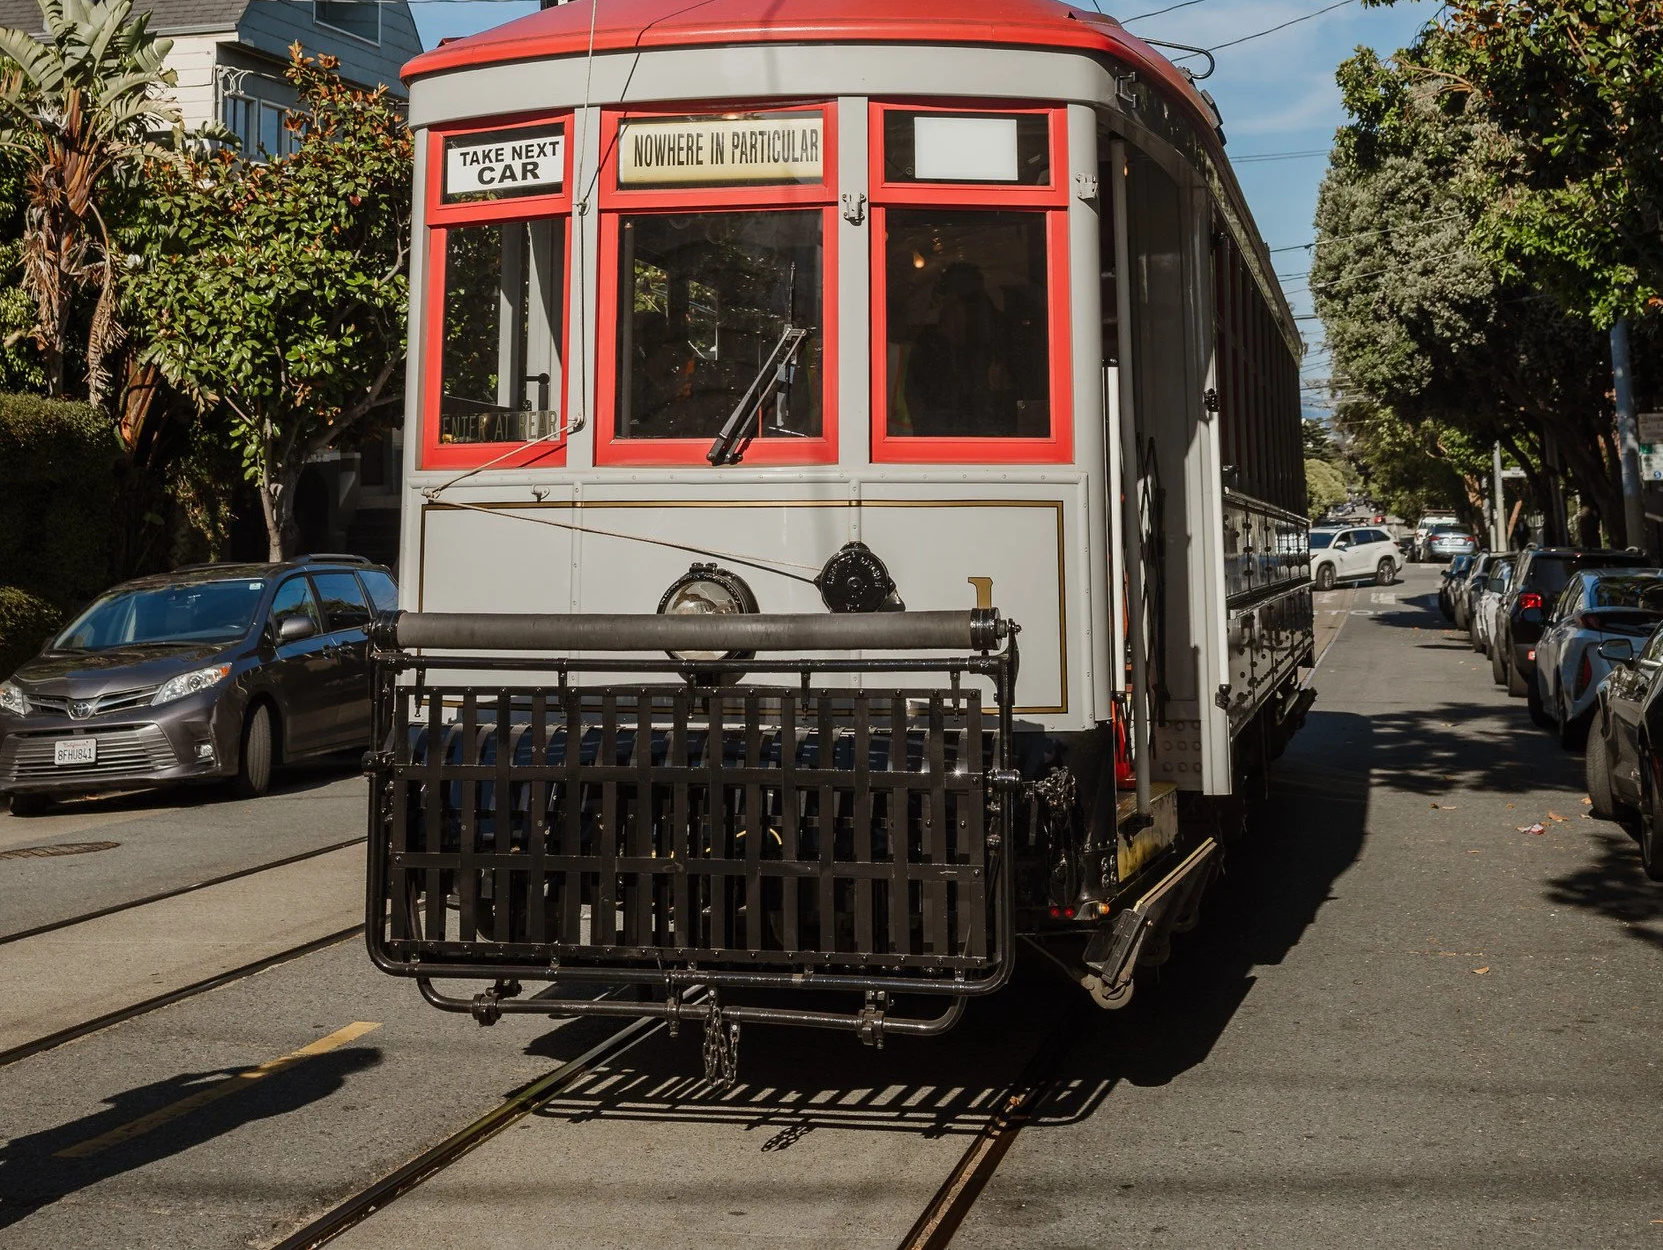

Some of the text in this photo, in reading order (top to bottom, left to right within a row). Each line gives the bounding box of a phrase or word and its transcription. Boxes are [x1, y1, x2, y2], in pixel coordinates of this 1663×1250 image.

[460, 141, 559, 166] TAKE NEXT
[634, 129, 818, 167] NOWHERE IN PARTICULAR
[478, 161, 540, 185] CAR
[442, 411, 558, 441] ENTER AT REAR
[57, 748, 92, 760] 8FHU841
